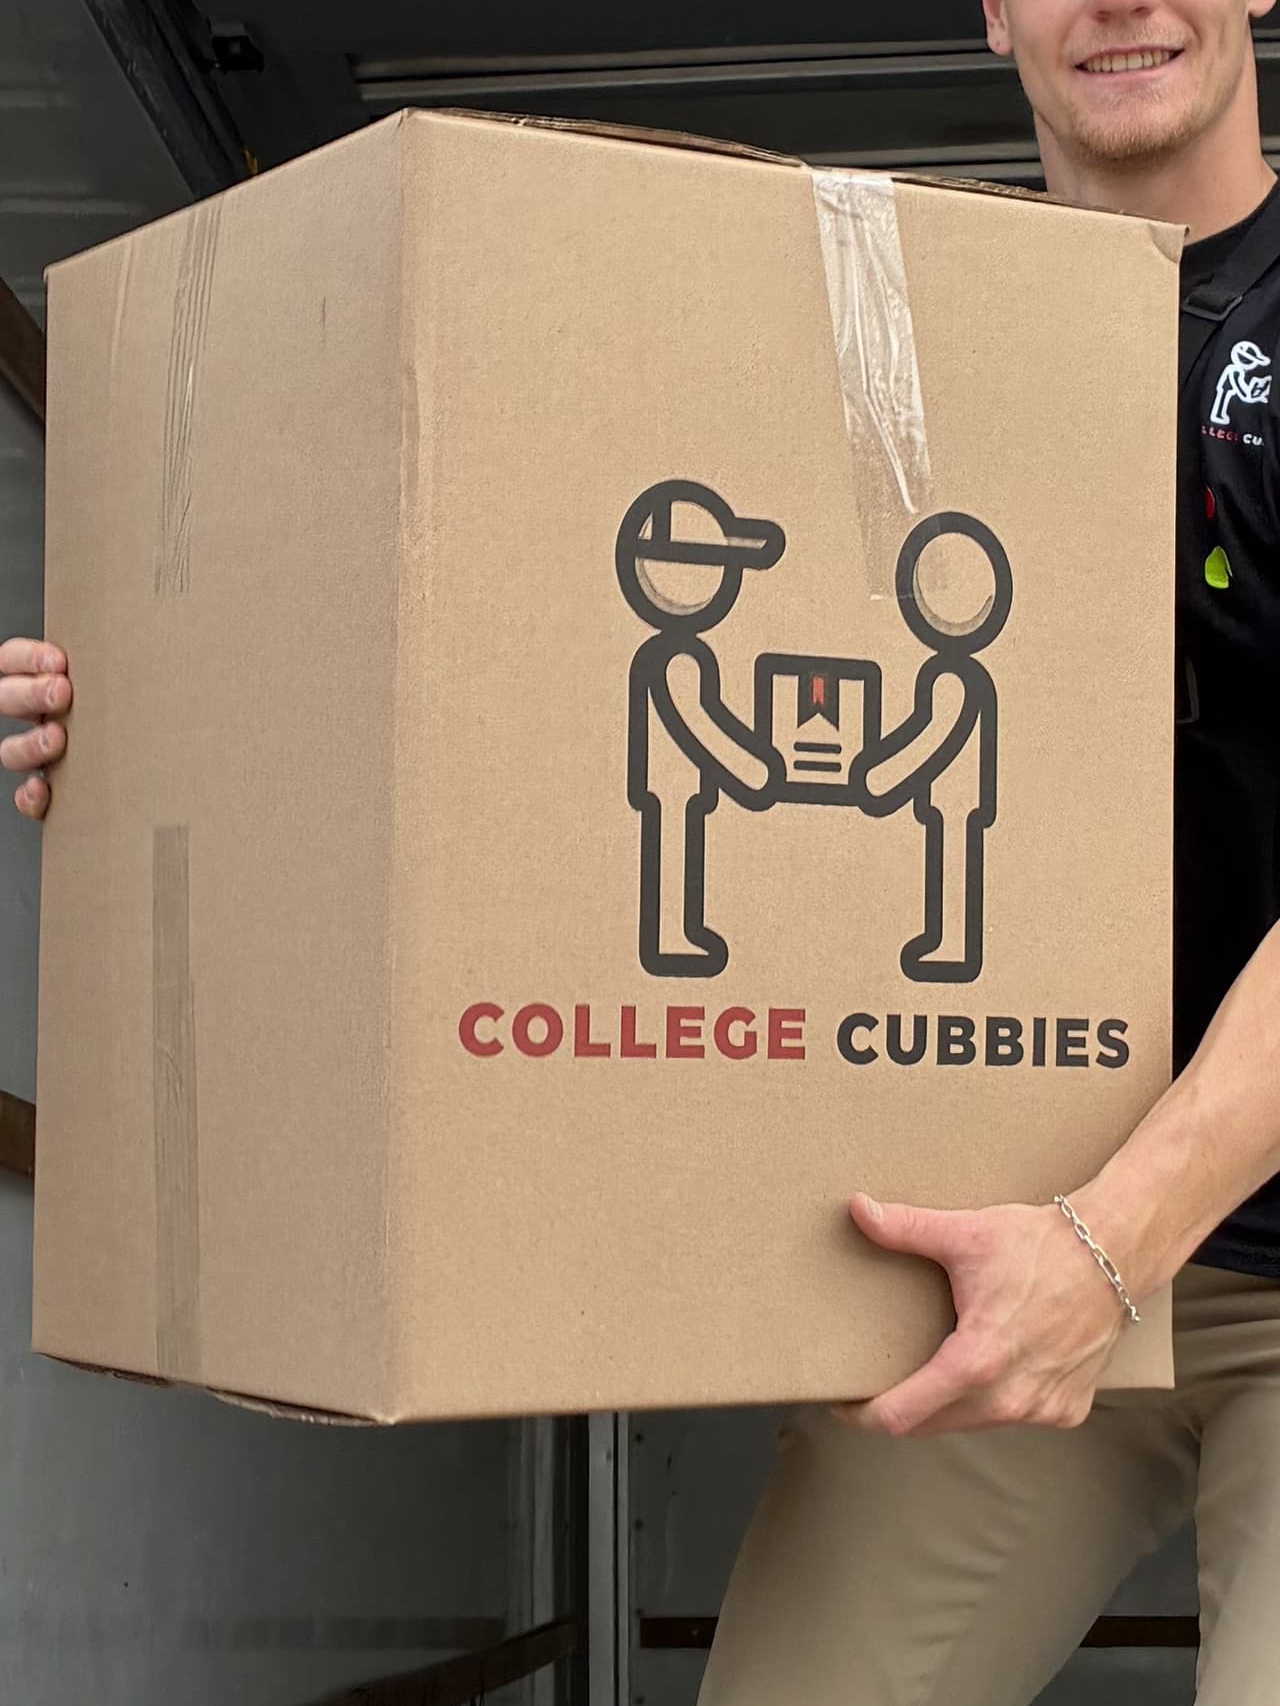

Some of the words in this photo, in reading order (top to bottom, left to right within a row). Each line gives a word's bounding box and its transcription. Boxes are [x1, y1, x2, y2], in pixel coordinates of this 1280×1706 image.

[1242, 434, 1264, 446] CU
[458, 1002, 807, 1060] COLLEGE
[836, 1012, 1130, 1069] CUBBIES
